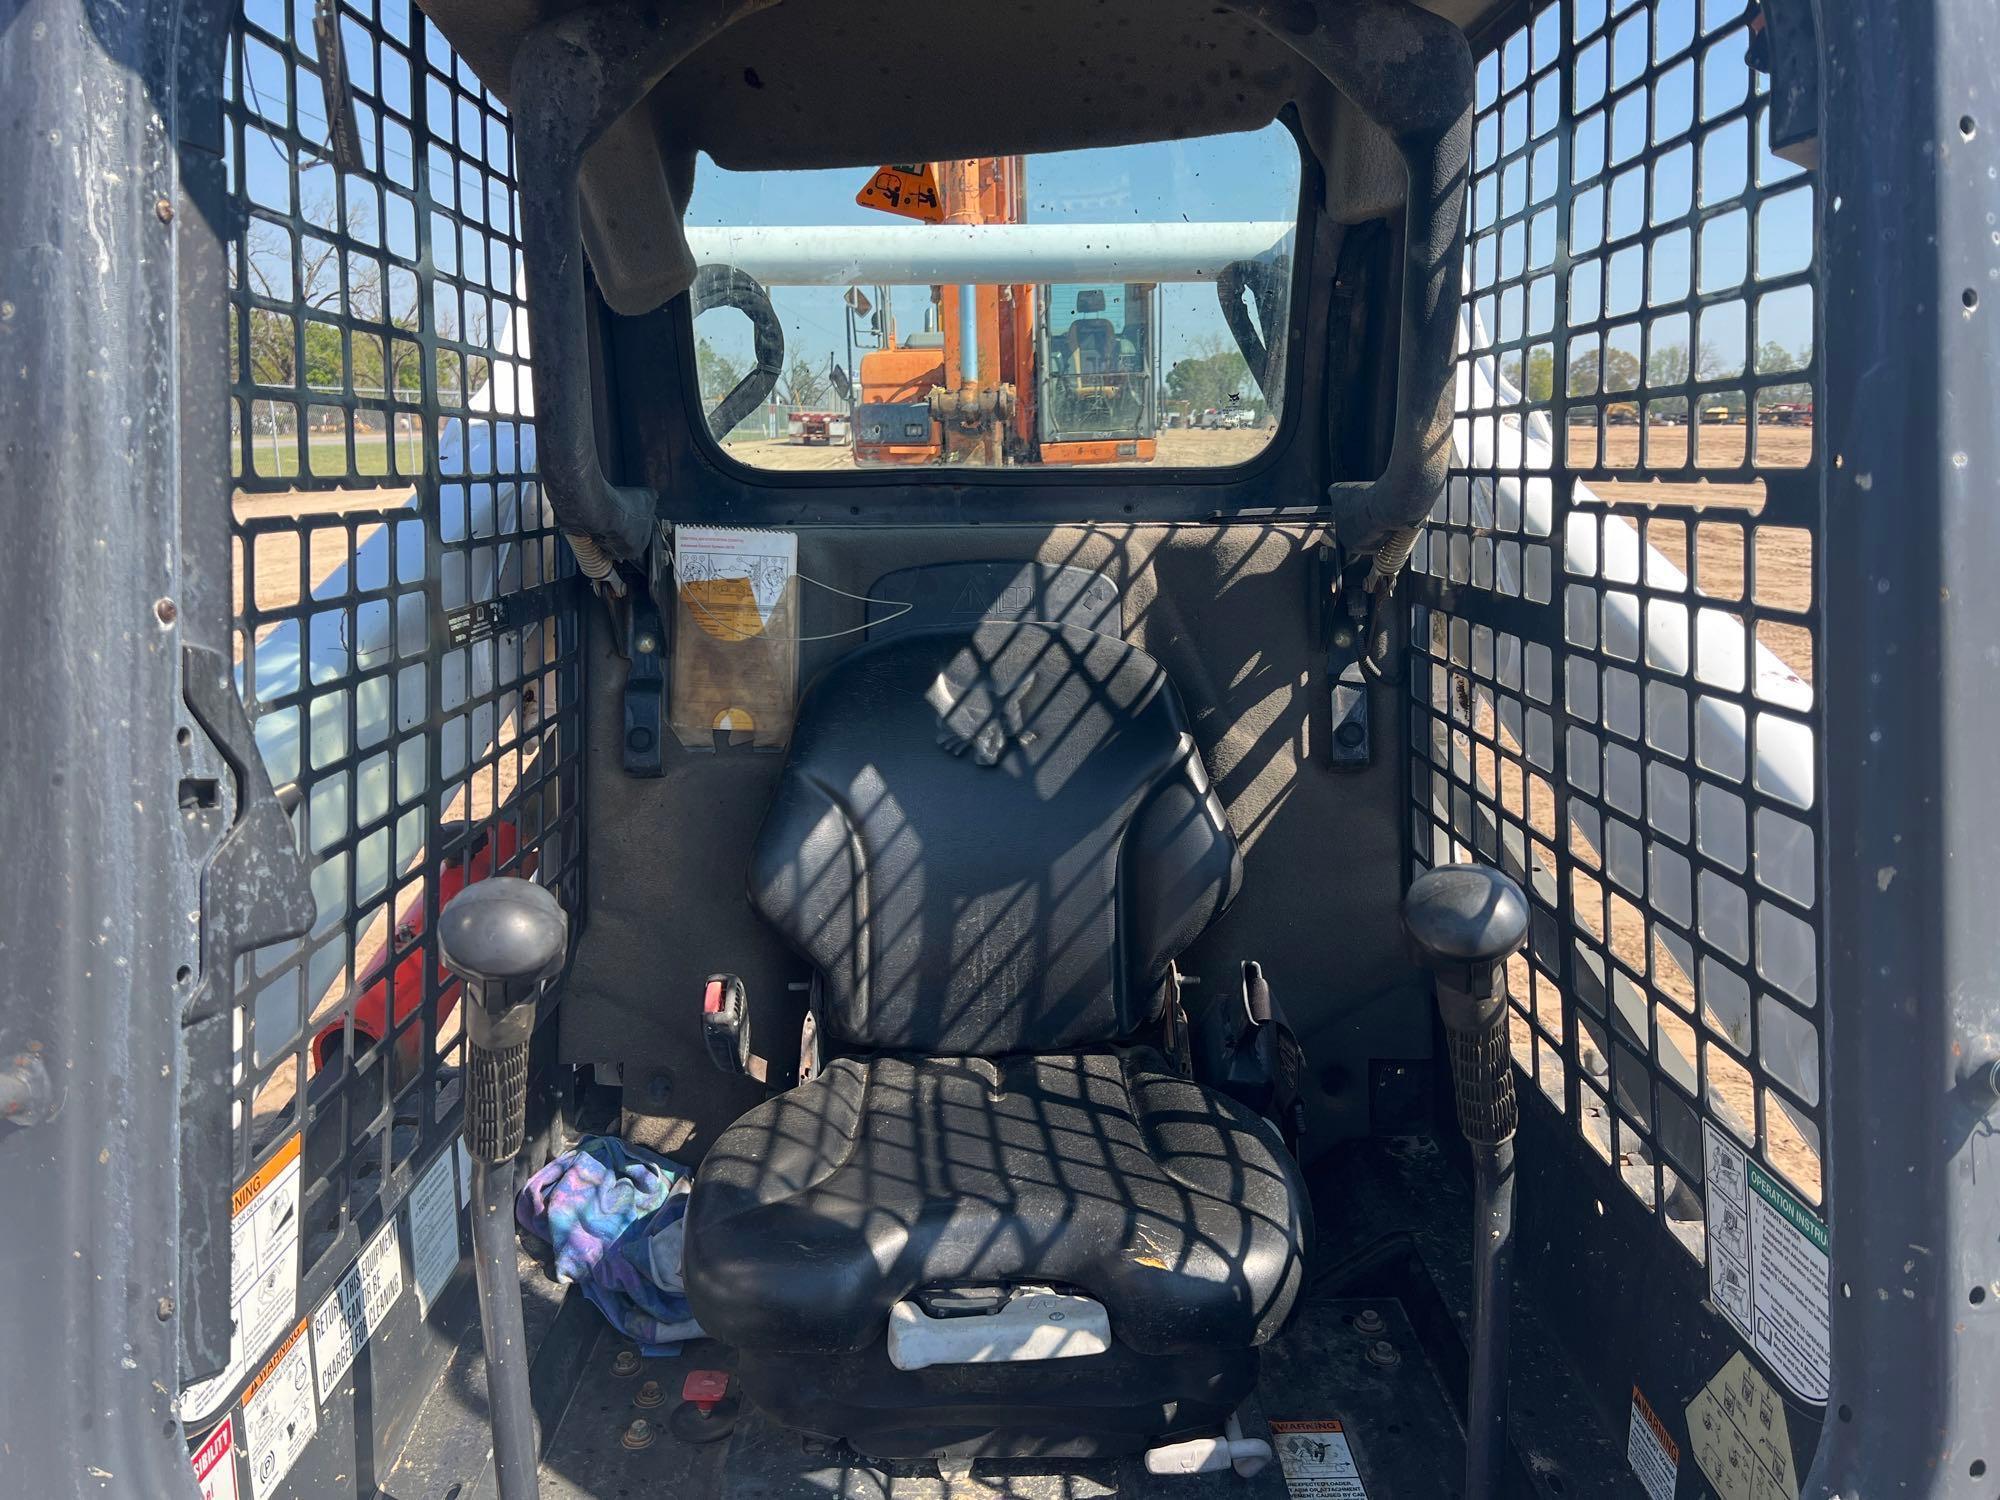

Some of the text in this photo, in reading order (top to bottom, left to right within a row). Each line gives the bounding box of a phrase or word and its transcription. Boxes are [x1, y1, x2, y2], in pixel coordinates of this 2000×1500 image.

[234, 1176, 261, 1212] NING
[246, 1195, 264, 1215] DEATH
[1751, 1170, 1829, 1247] OPERATION INSTRU
[316, 1221, 396, 1342] RETURN THIS EQUIPMENT
[339, 1268, 381, 1339] CLEAN OR BE
[259, 1328, 301, 1386] WARNING
[322, 1273, 399, 1392] CHARGED FOR CLEANING
[193, 1429, 228, 1476] SIBILITY
[1277, 1422, 1336, 1431] WARNING
[1641, 1397, 1679, 1462] WARNING
